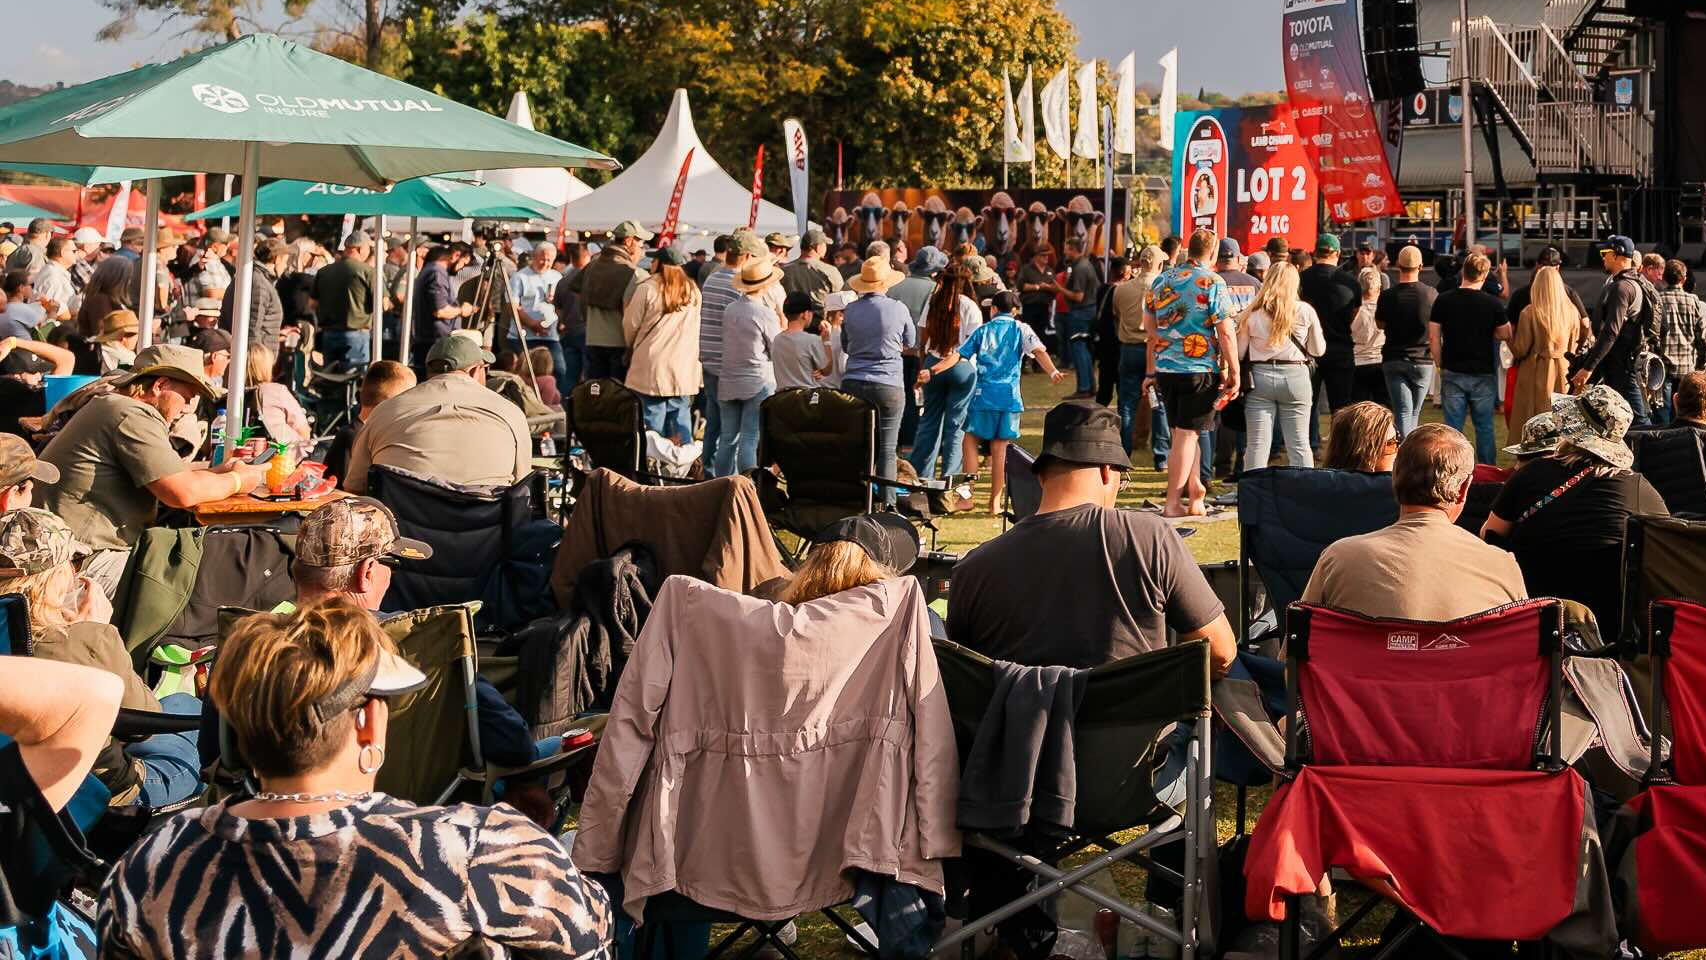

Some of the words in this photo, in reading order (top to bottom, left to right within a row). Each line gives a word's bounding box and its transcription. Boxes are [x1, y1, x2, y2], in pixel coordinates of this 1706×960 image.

[1289, 16, 1333, 37] TOYOTA
[263, 106, 330, 119] INSURE
[1237, 167, 1284, 203] LOT
[1291, 165, 1307, 201] 2
[1270, 214, 1290, 234] KG
[1390, 635, 1416, 643] CAMP
